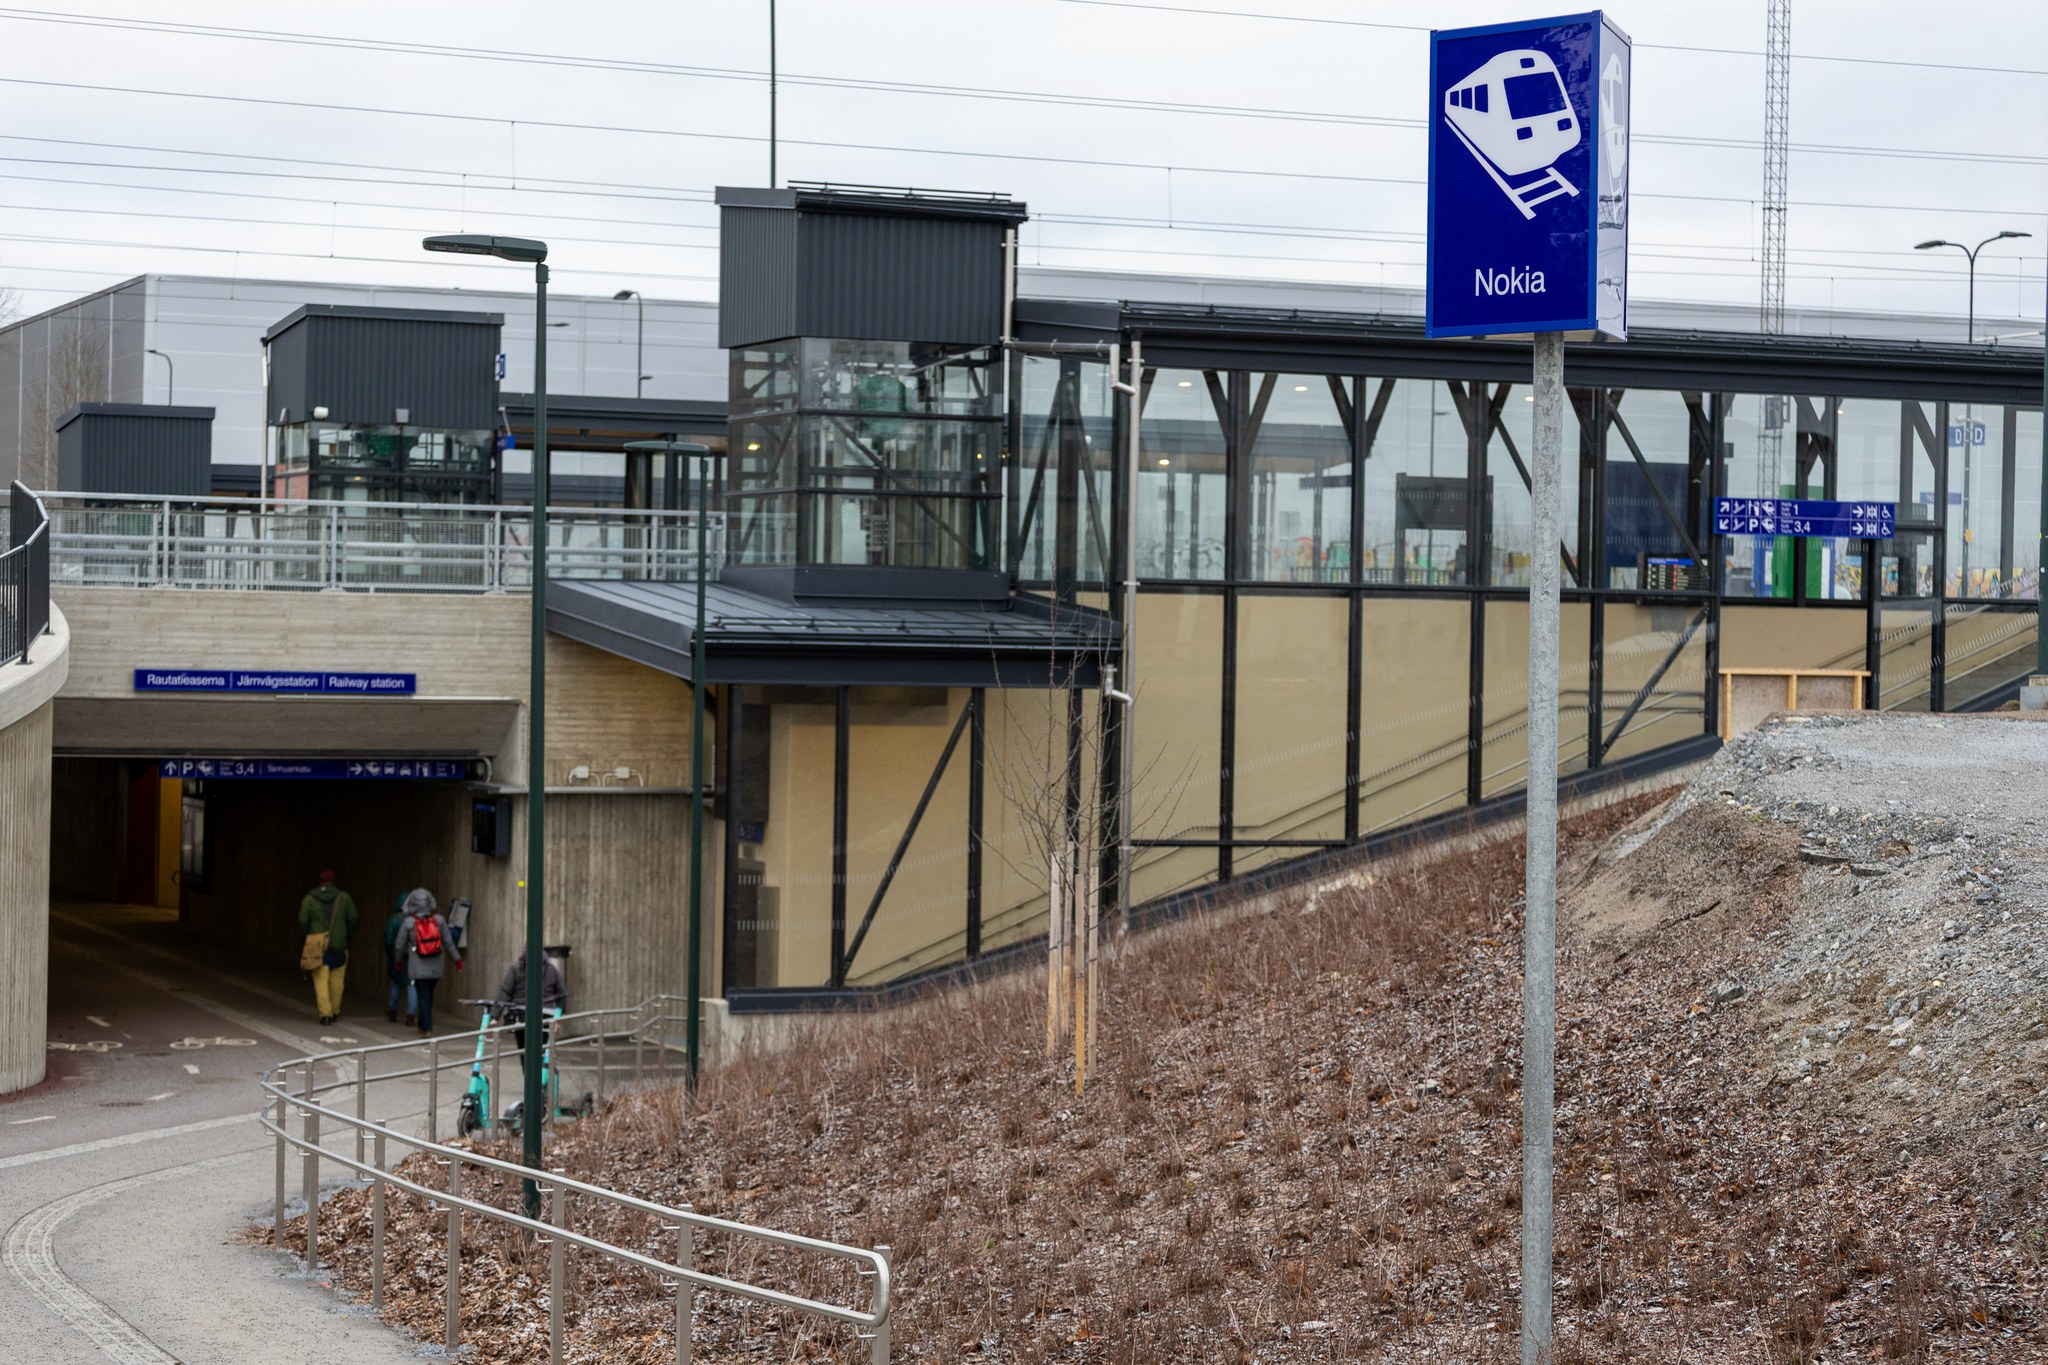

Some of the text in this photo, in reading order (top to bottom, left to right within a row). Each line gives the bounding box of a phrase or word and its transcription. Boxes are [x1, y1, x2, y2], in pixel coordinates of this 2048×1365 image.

[1475, 265, 1546, 297] Nokia
[1974, 427, 1984, 443] D
[1793, 503, 1799, 516] 1
[1749, 520, 1759, 532] P
[1793, 520, 1811, 534] 3,4
[146, 672, 406, 691] Rautatieasema Järnvägsstation Railway station
[182, 761, 194, 775] P
[235, 762, 255, 776] 3,4
[451, 763, 456, 775] 1
